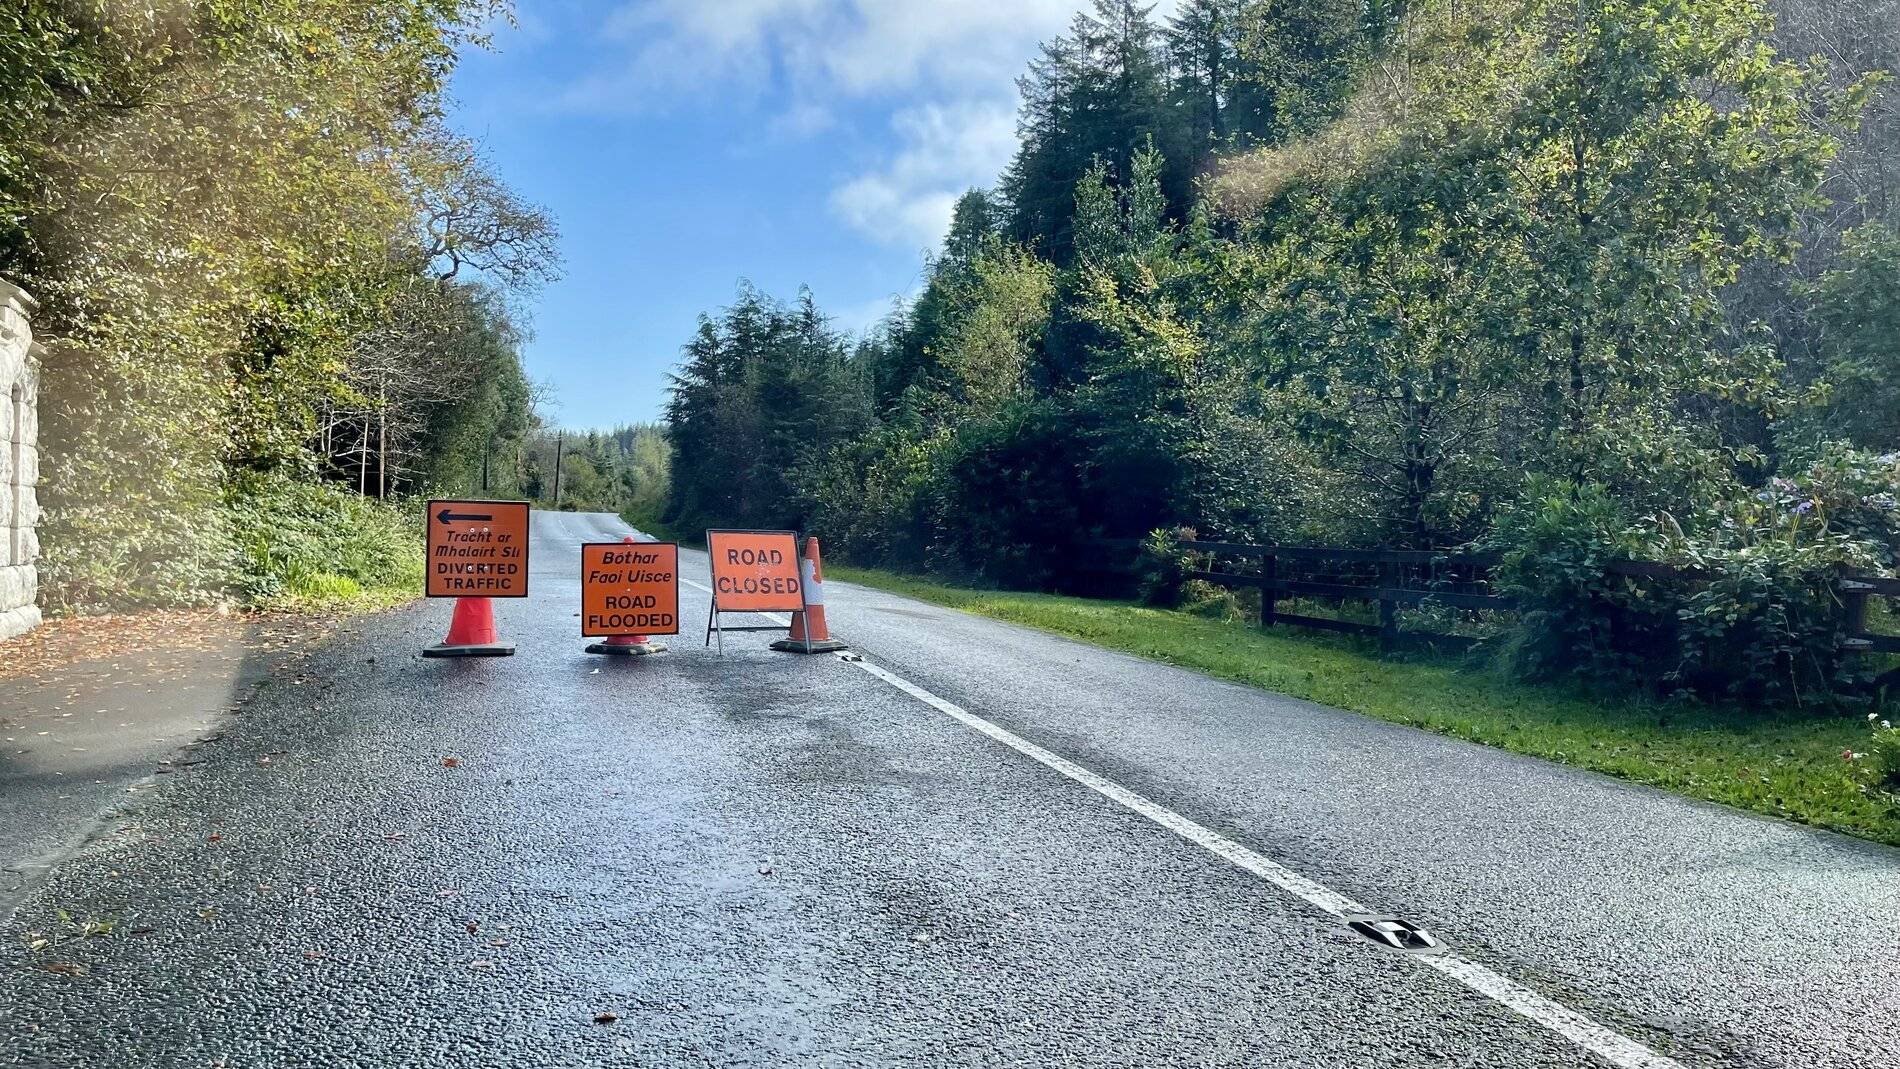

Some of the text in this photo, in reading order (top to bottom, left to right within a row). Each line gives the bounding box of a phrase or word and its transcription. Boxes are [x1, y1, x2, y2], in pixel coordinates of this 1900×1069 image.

[447, 530, 512, 543] Tracht ar
[435, 545, 496, 557] Mhalairt
[727, 549, 783, 565] ROAD
[437, 563, 518, 575] DIVERTED
[589, 570, 672, 583] Faoi Uisce
[444, 578, 512, 589] TRAFFIC
[717, 577, 799, 594] CLOSED
[605, 595, 656, 609] ROAD
[588, 613, 673, 628] FLOODED
